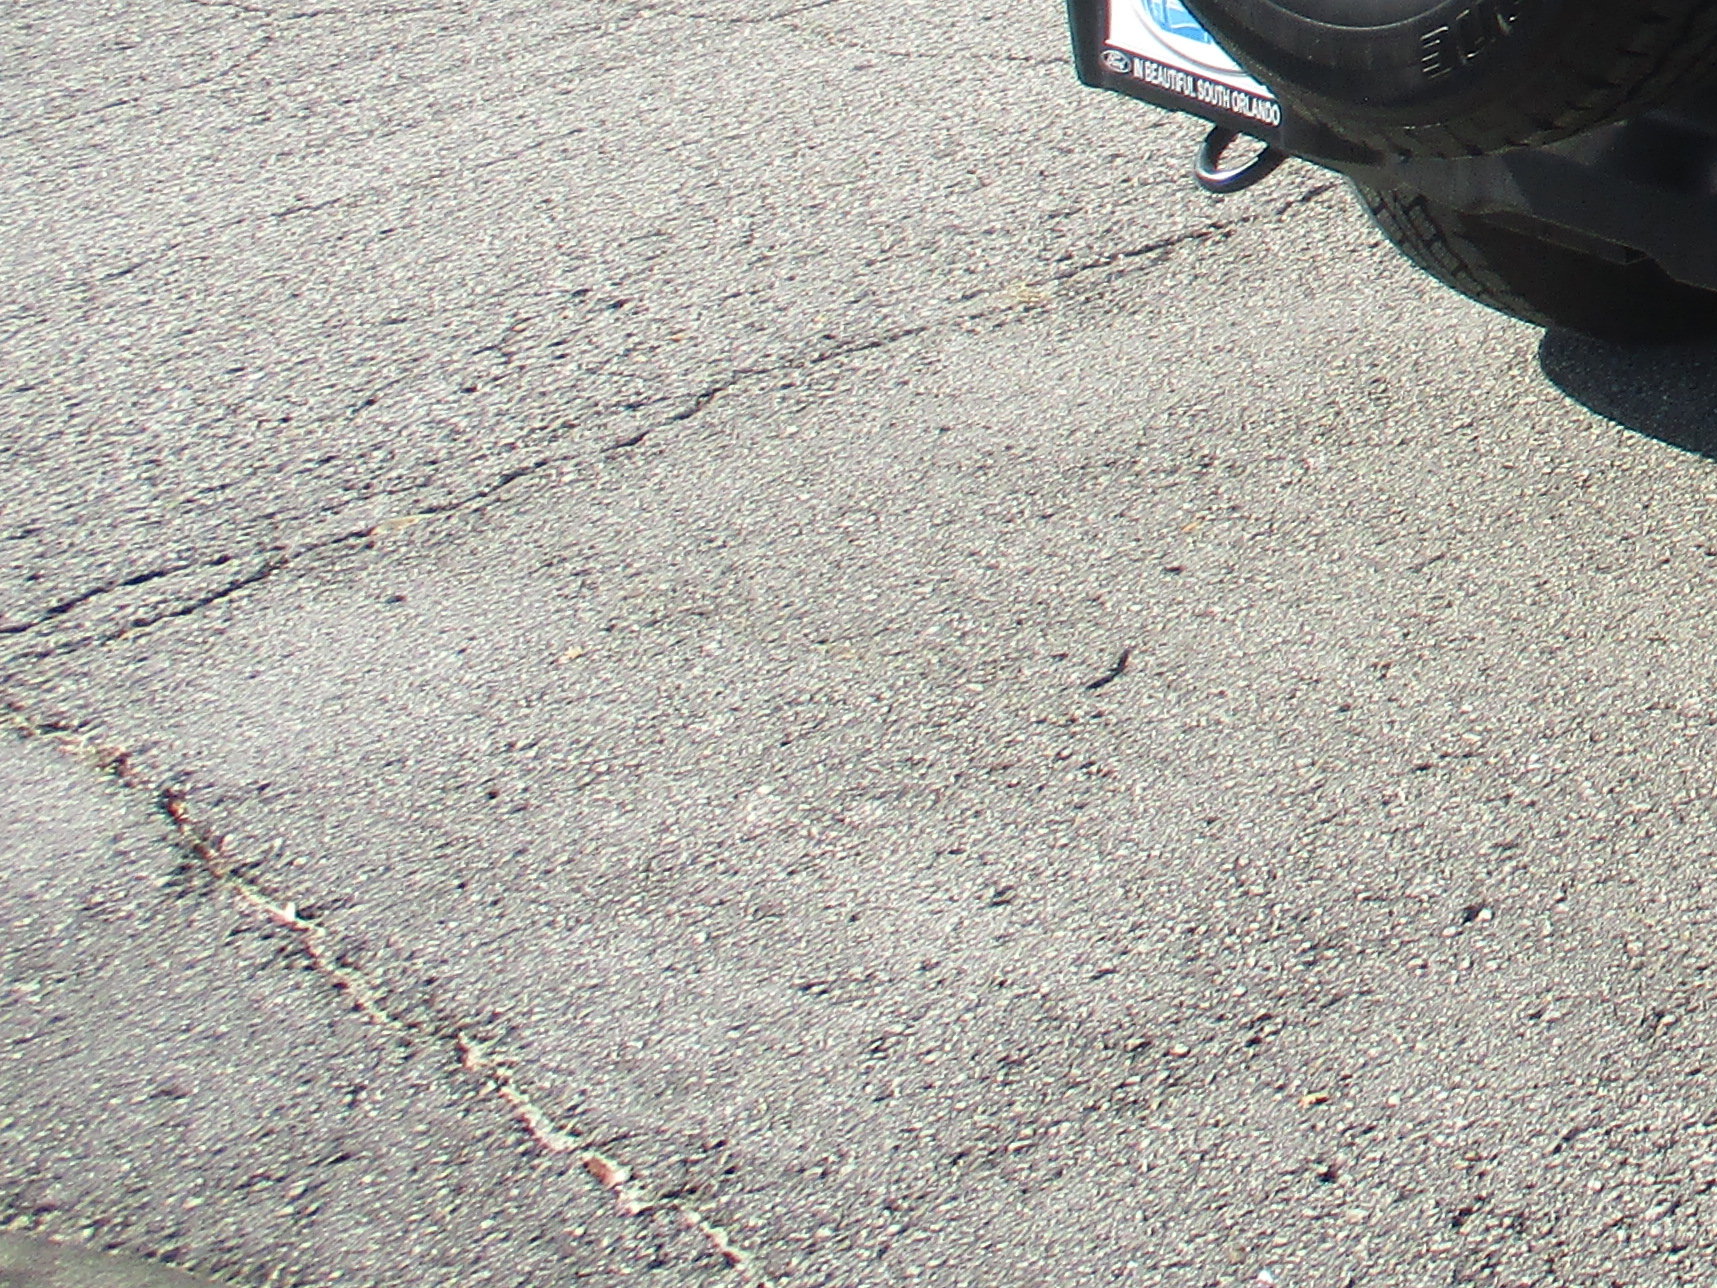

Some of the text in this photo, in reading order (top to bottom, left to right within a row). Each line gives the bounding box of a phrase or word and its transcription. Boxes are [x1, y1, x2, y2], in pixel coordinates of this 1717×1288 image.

[1133, 57, 1282, 127] IN BEAUTIFUL SOUTH ORLANDO
